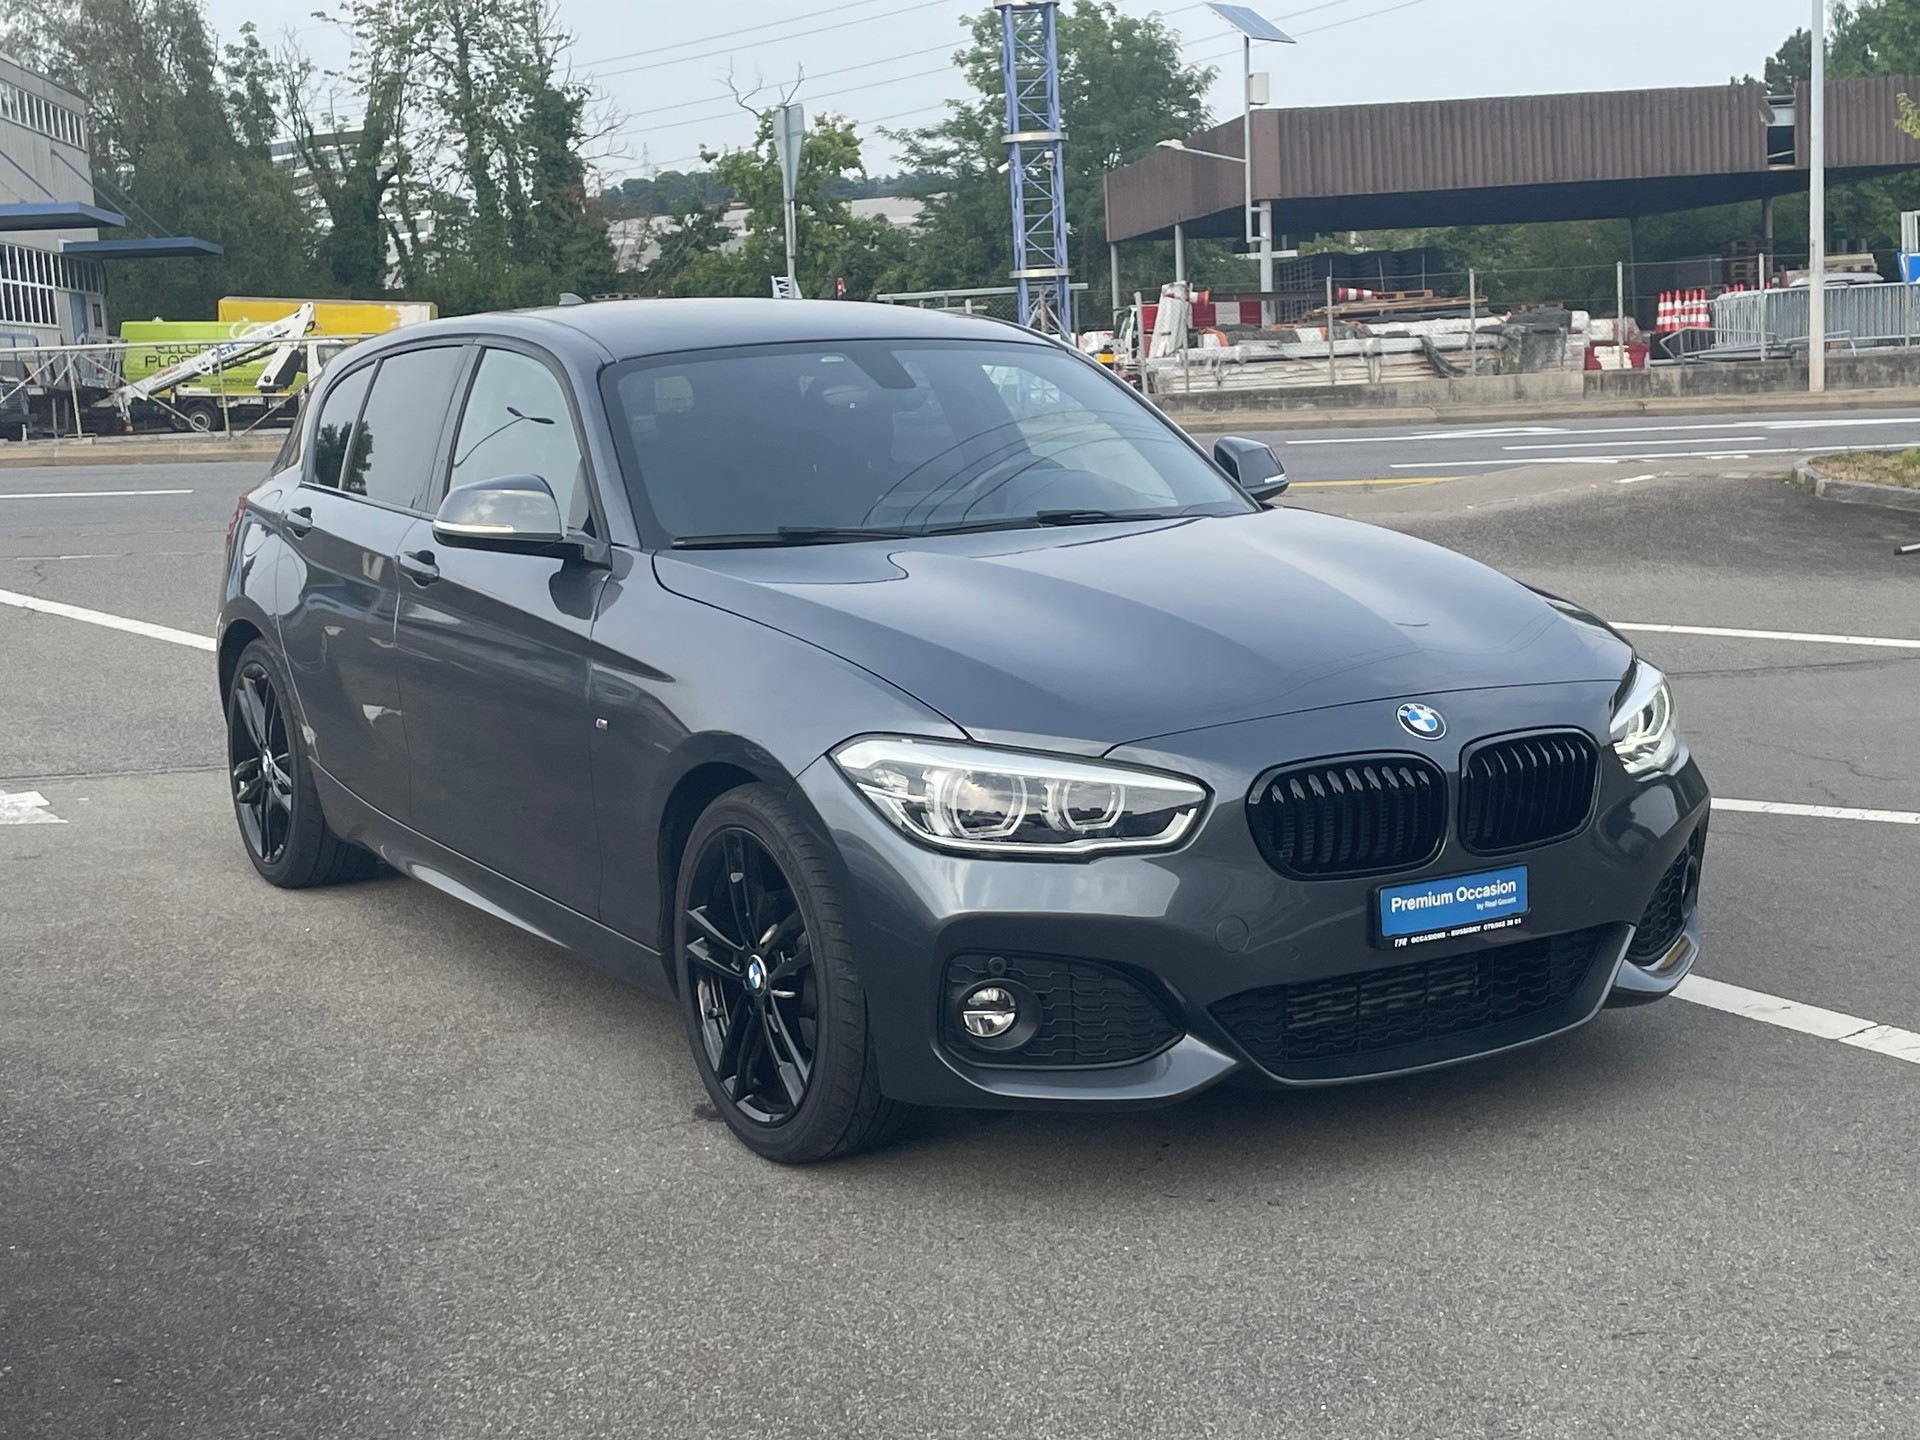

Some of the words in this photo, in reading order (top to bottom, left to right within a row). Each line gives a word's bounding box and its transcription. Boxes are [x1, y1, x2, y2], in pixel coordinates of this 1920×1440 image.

[1391, 891, 1453, 913] Premium
[1456, 879, 1517, 902] Occasion
[1476, 902, 1484, 911] by
